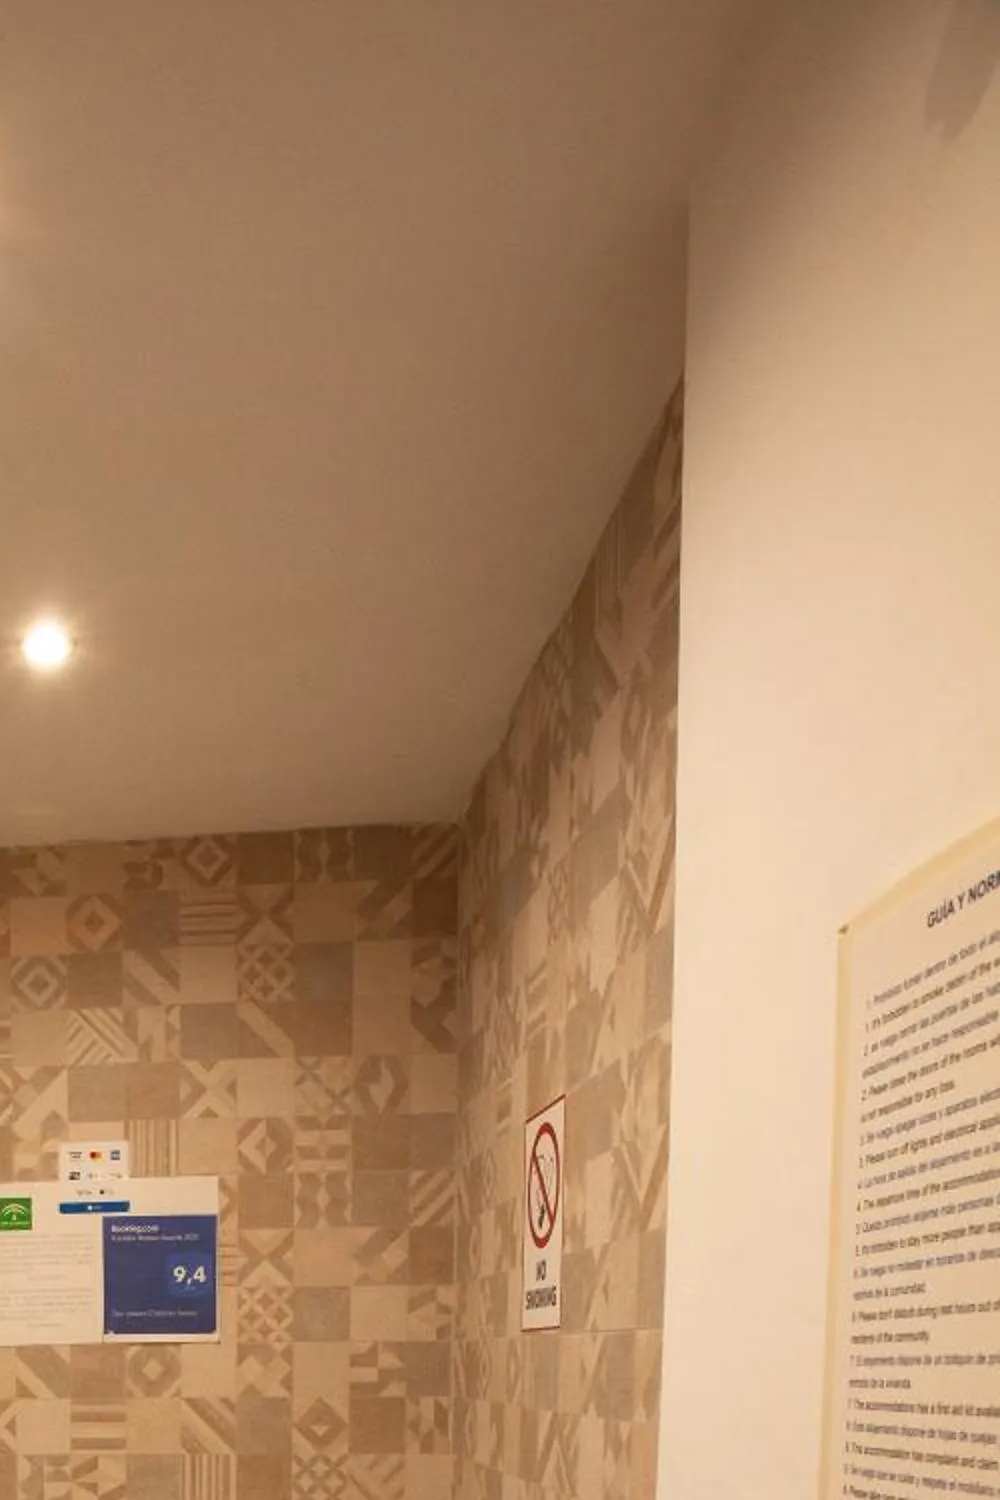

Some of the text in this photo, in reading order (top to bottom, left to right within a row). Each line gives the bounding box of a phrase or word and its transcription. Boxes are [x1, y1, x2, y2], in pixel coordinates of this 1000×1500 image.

[957, 892, 966, 911] Y
[967, 870, 1000, 904] NOR
[173, 1265, 208, 1285] 9,4
